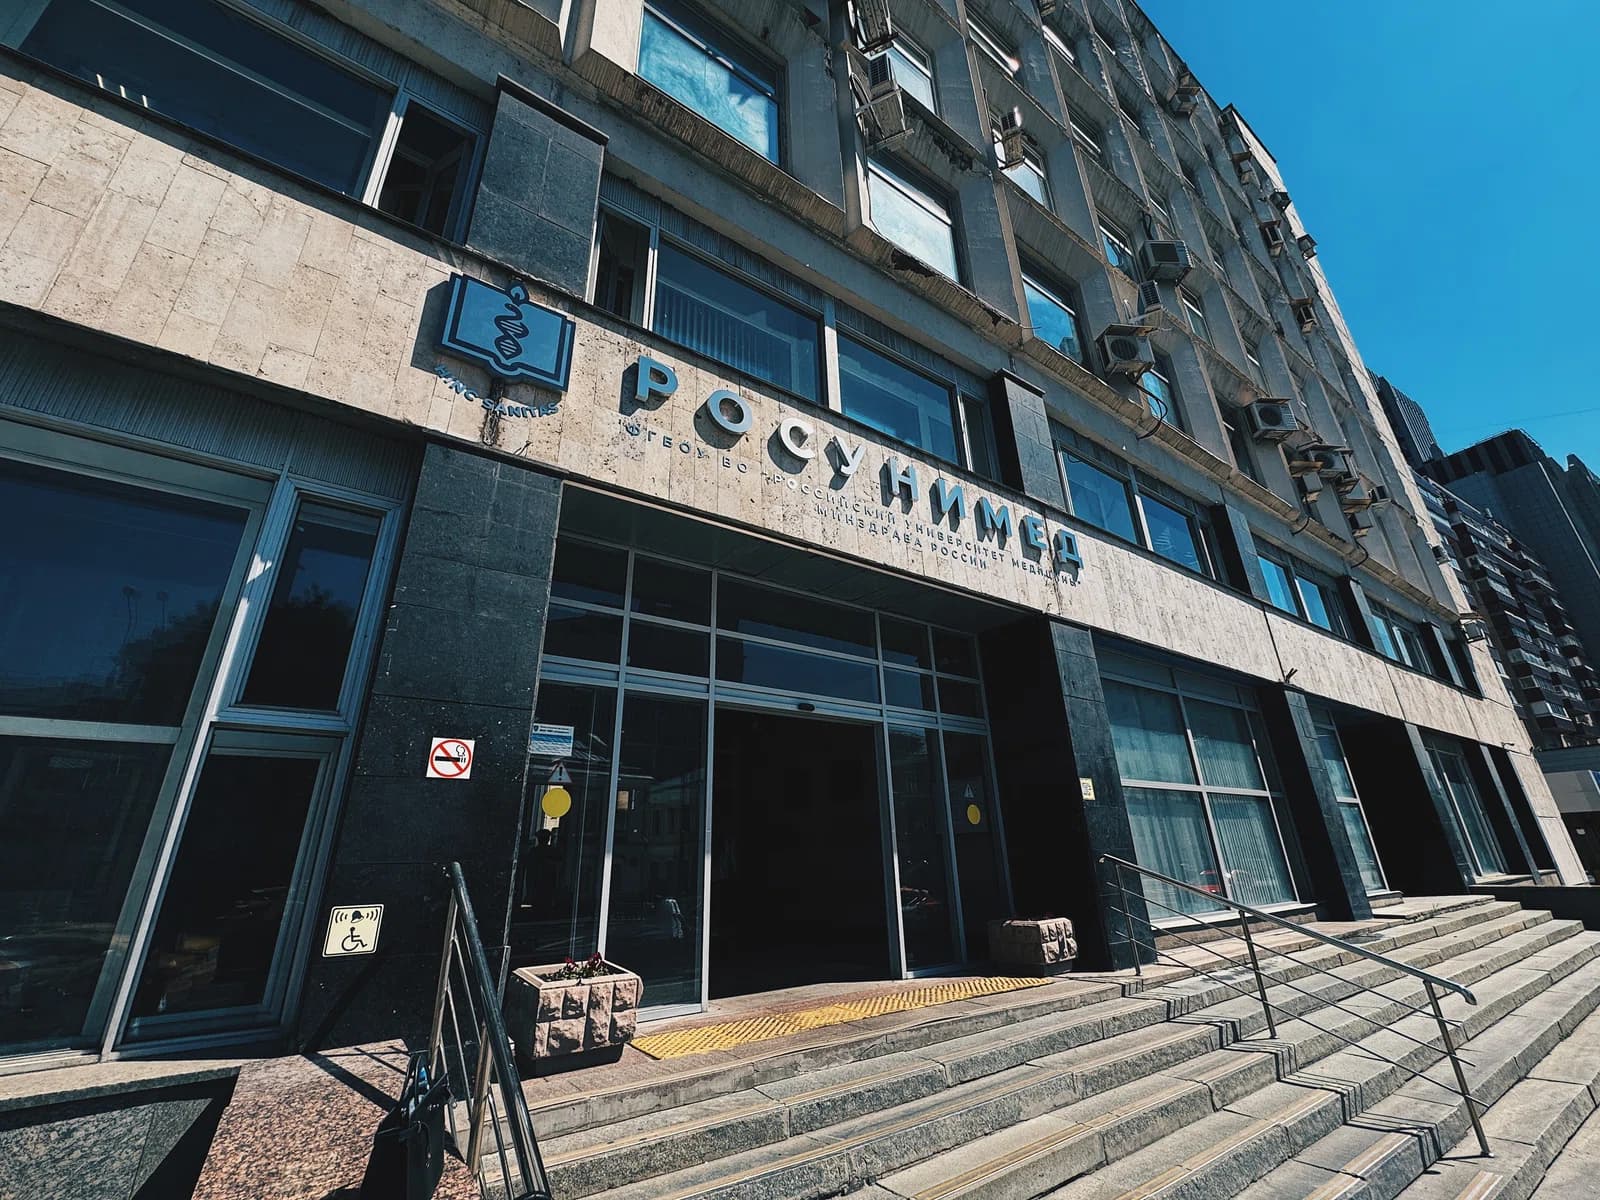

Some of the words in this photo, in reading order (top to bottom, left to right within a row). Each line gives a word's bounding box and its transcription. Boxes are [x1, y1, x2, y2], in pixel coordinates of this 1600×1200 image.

[481, 398, 559, 418] SANITAS
[634, 355, 1085, 571] РОСУНИМЕД
[722, 455, 748, 474] ВО
[904, 519, 1005, 563] УНИВЕРСИТЕТ
[815, 503, 923, 549] МИНЗДРАВА
[931, 543, 988, 570] РОССИИ
